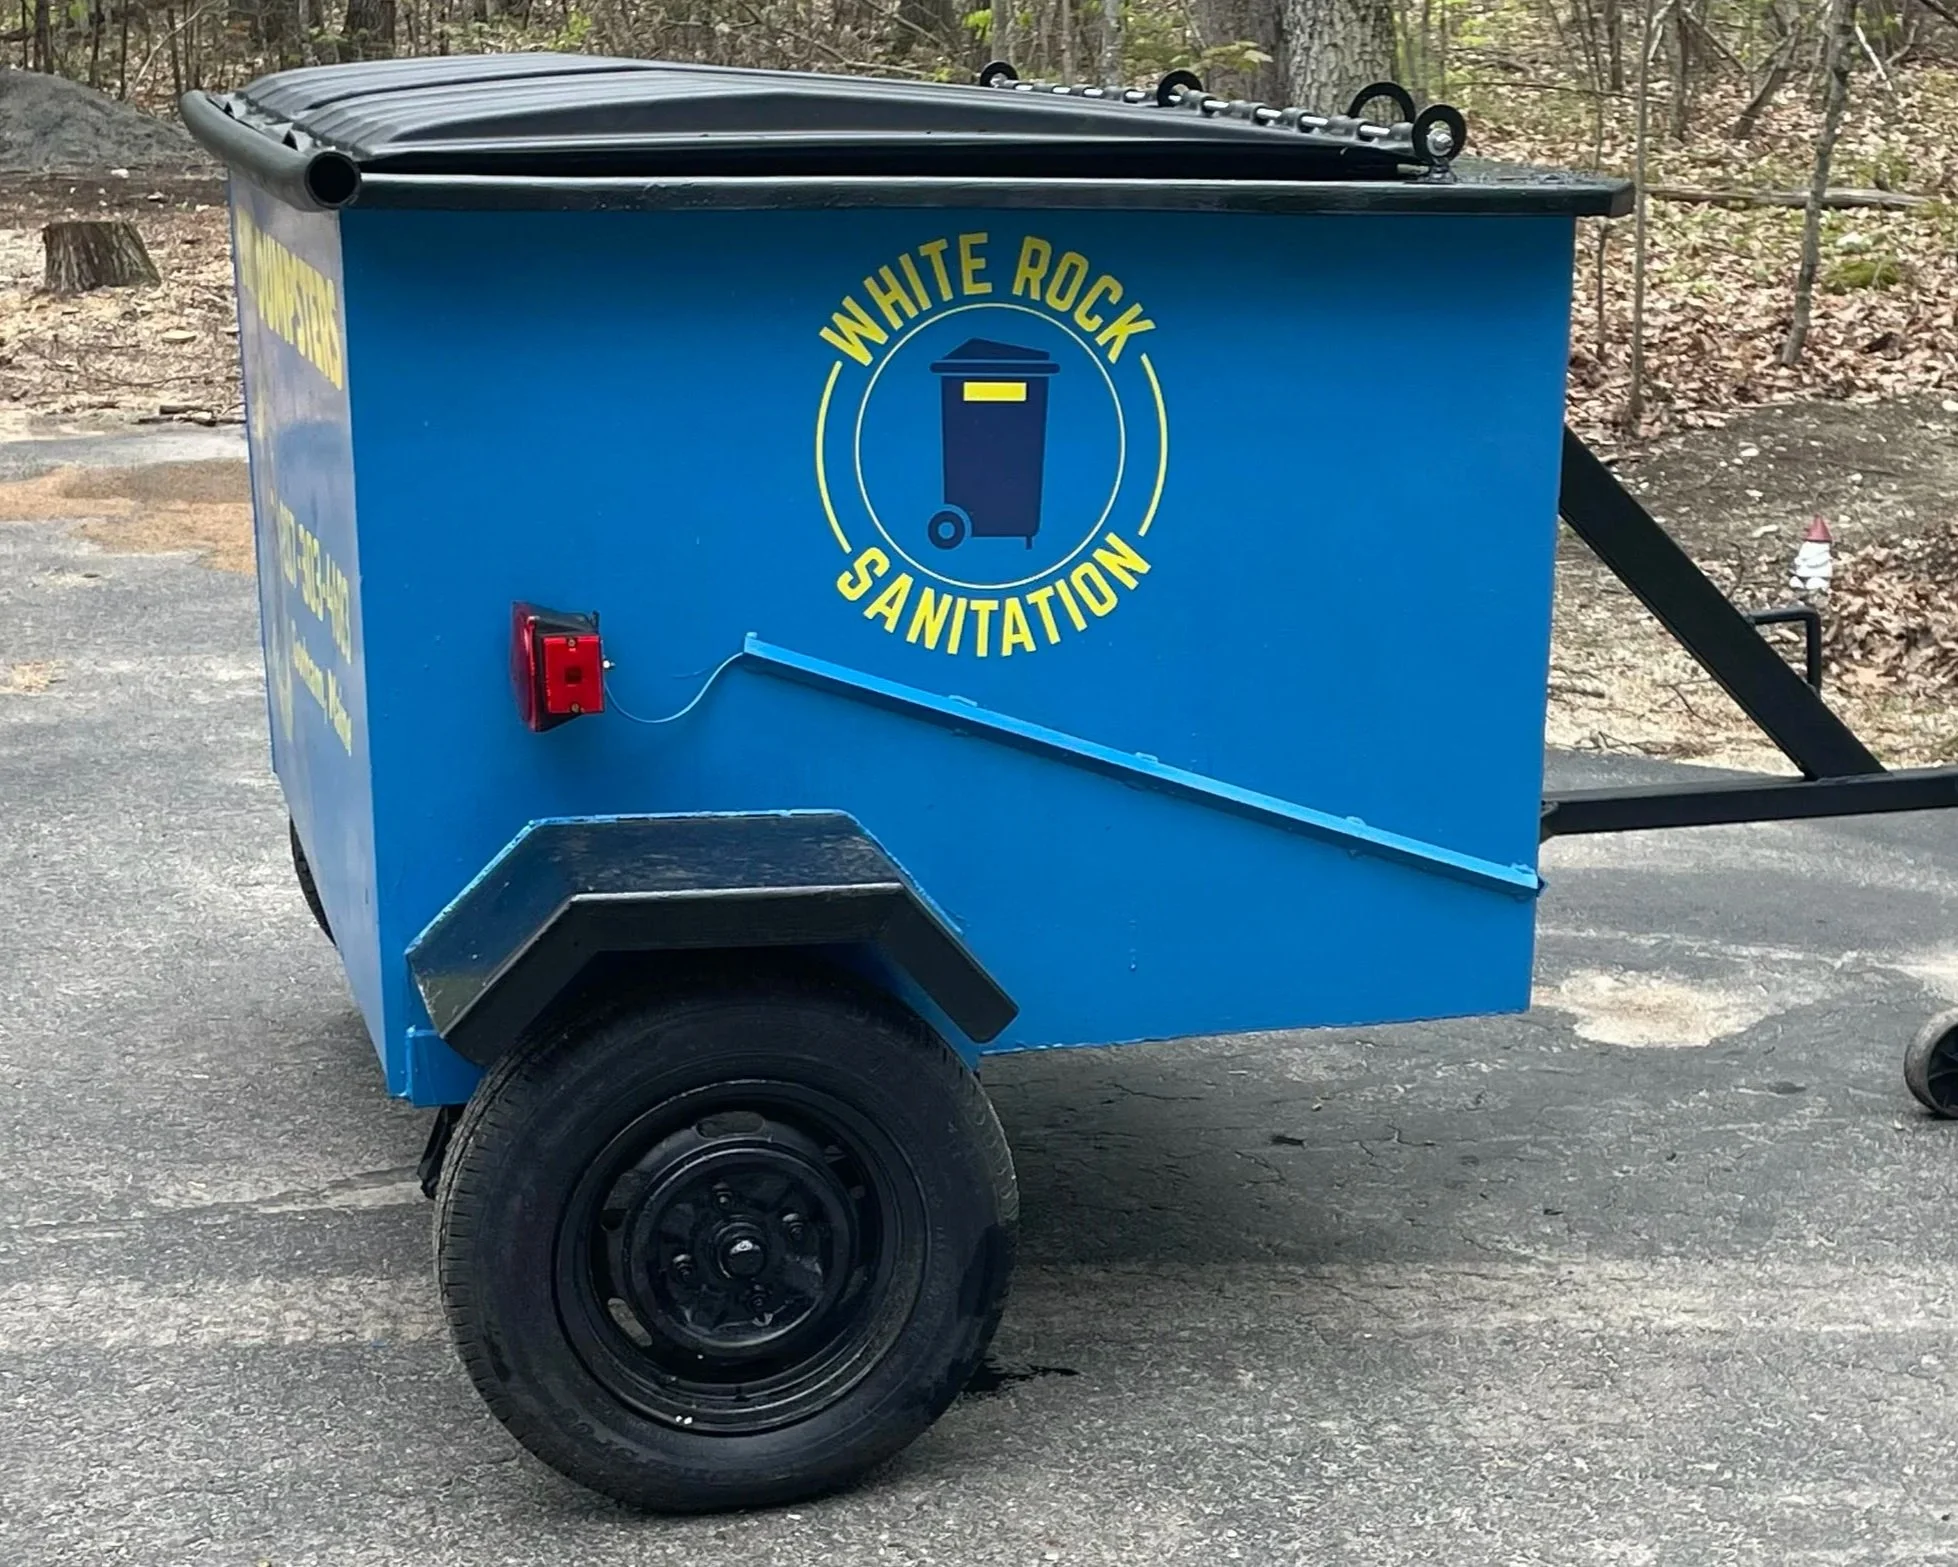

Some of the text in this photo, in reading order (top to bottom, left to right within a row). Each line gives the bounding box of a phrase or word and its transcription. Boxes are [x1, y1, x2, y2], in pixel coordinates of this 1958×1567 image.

[819, 232, 1156, 367] WHITE ROCK
[836, 532, 1151, 657] SANITATION
